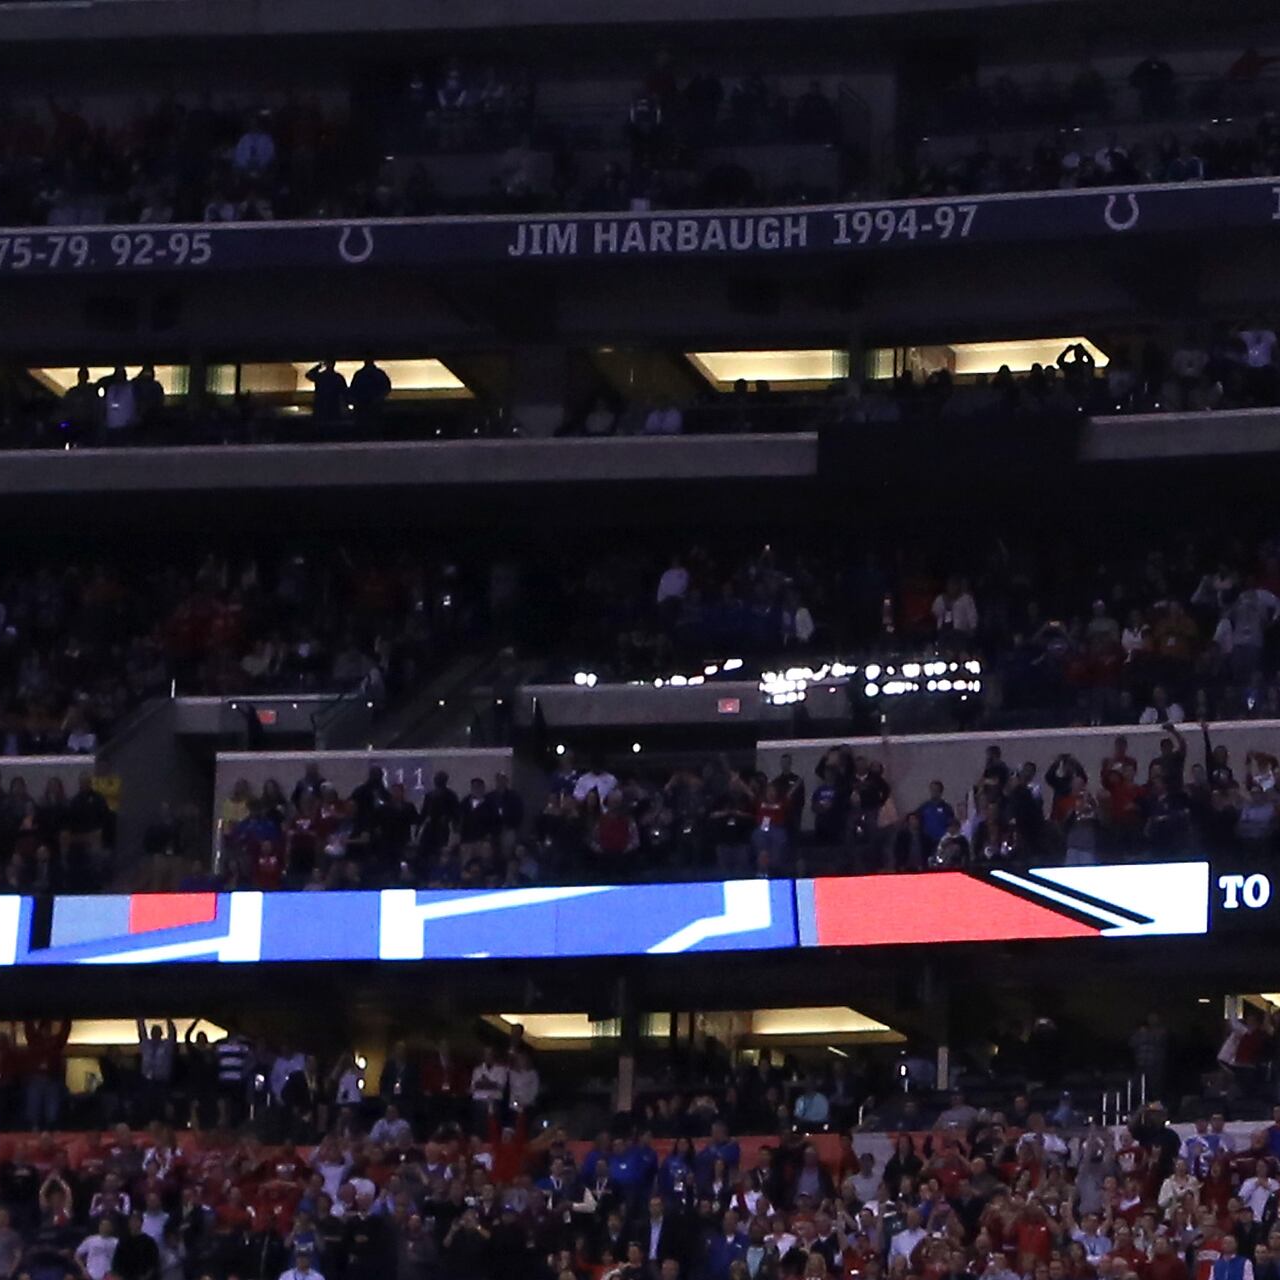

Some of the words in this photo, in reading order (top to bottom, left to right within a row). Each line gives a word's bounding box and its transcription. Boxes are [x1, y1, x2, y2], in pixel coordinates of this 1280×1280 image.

[508, 222, 578, 257] JIM
[593, 215, 809, 254] HARBAUGH
[832, 204, 979, 245] 1994-97
[110, 232, 212, 265] 92-95
[1220, 875, 1270, 908] TO
